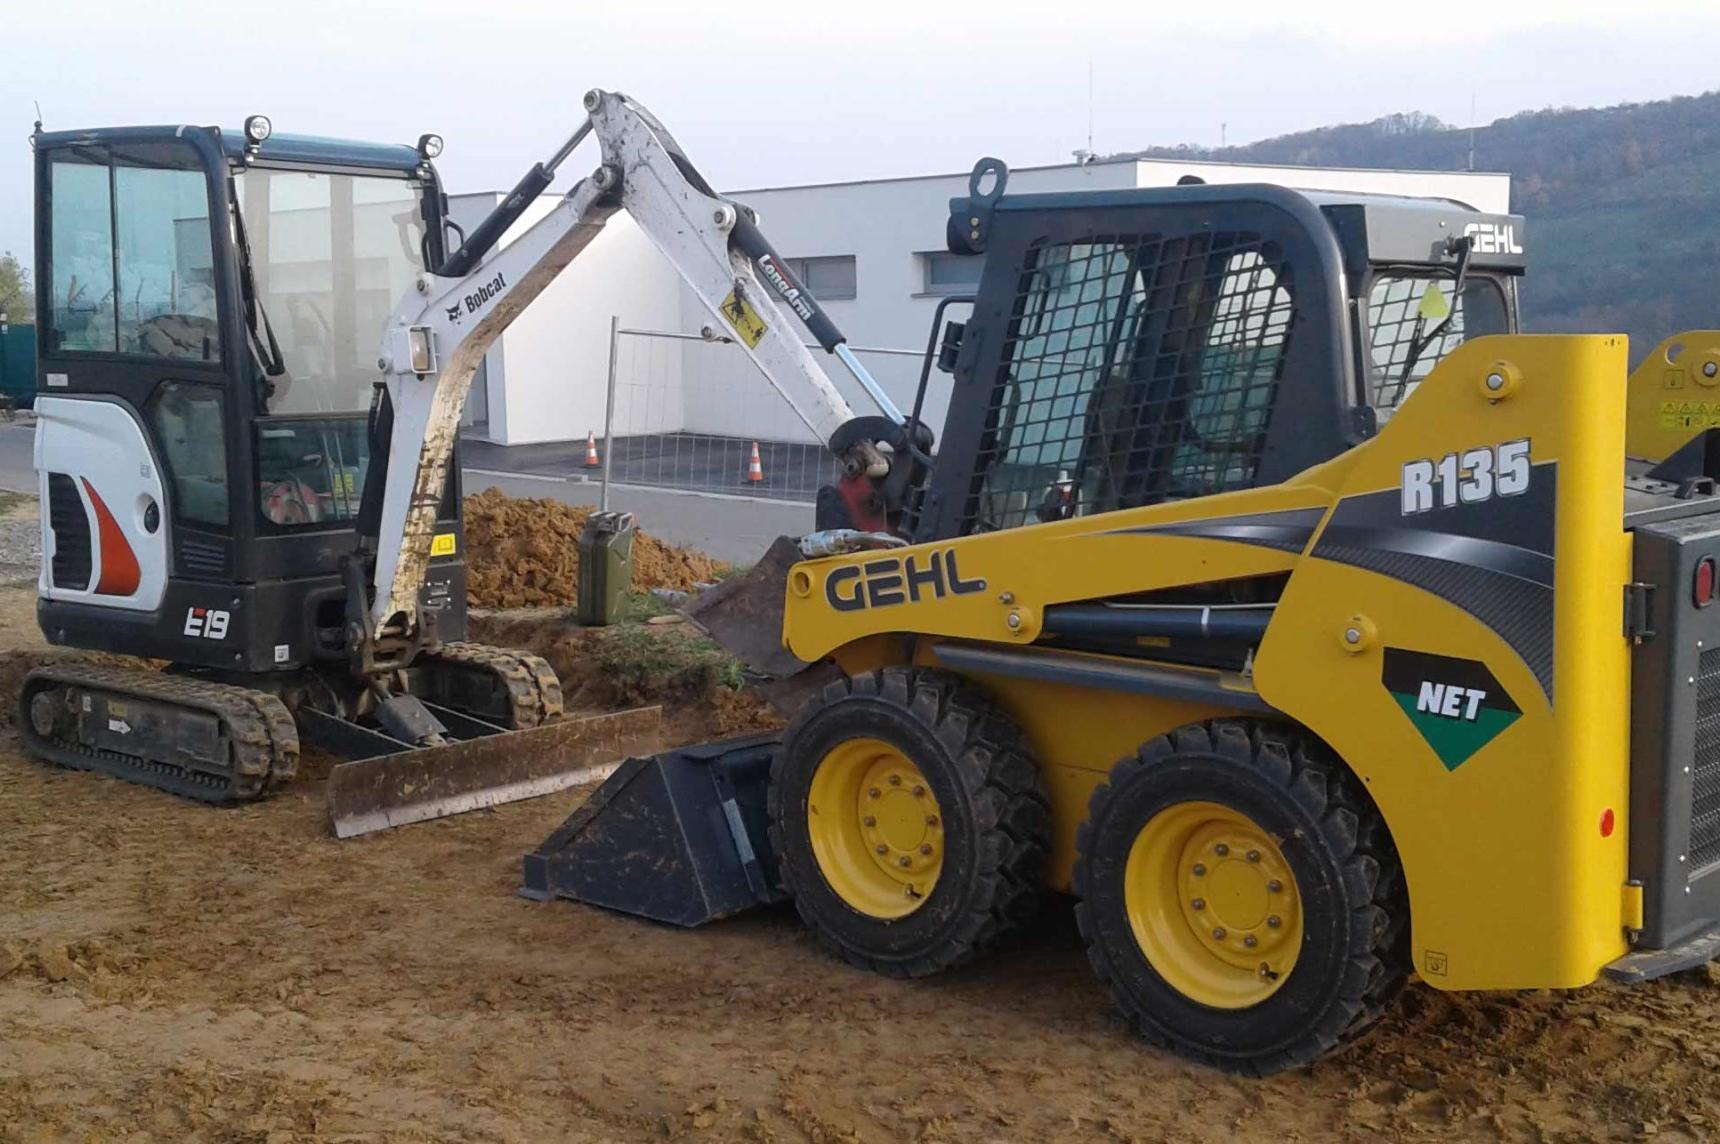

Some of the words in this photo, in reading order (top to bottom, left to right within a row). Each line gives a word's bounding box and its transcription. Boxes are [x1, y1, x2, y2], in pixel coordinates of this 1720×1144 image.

[1464, 223, 1523, 254] GEHL
[464, 272, 506, 313] Bobcat
[758, 254, 811, 321] LongArm
[1401, 437, 1531, 516] R135
[825, 547, 987, 612] GEHL
[183, 606, 230, 640] E19
[1416, 681, 1486, 720] NET
